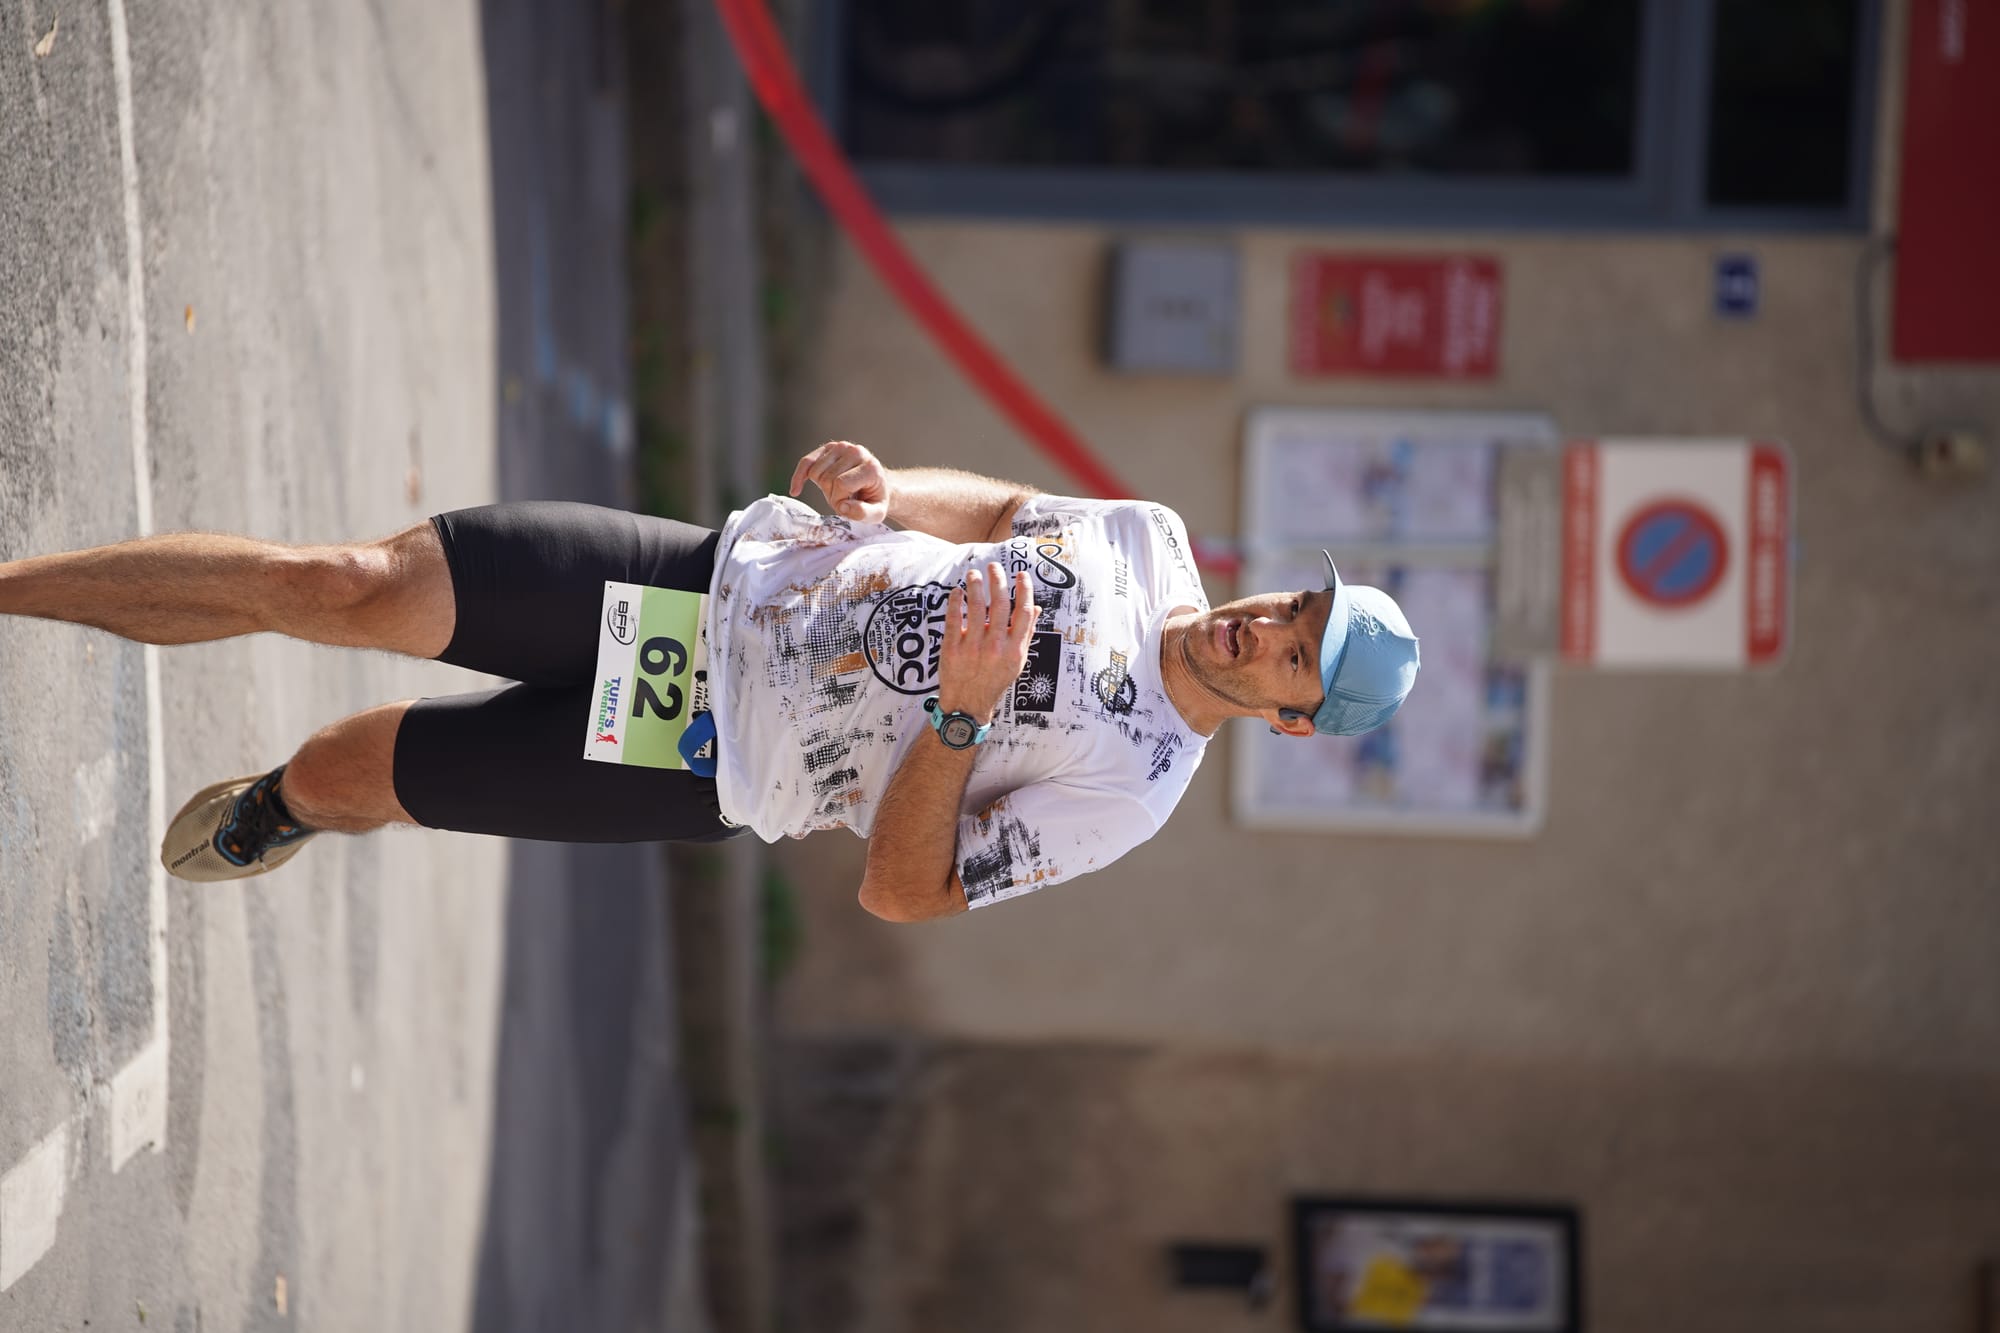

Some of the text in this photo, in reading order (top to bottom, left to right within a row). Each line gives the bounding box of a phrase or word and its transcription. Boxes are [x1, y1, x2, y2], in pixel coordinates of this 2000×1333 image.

[1114, 560, 1128, 598] GOBIK
[616, 600, 628, 638] BFP
[874, 620, 884, 664] permanent
[884, 618, 893, 666] vide grenier
[894, 593, 924, 686] TROC
[604, 676, 622, 728] TUFF'S
[632, 636, 688, 721] 62
[598, 680, 613, 732] Aventure
